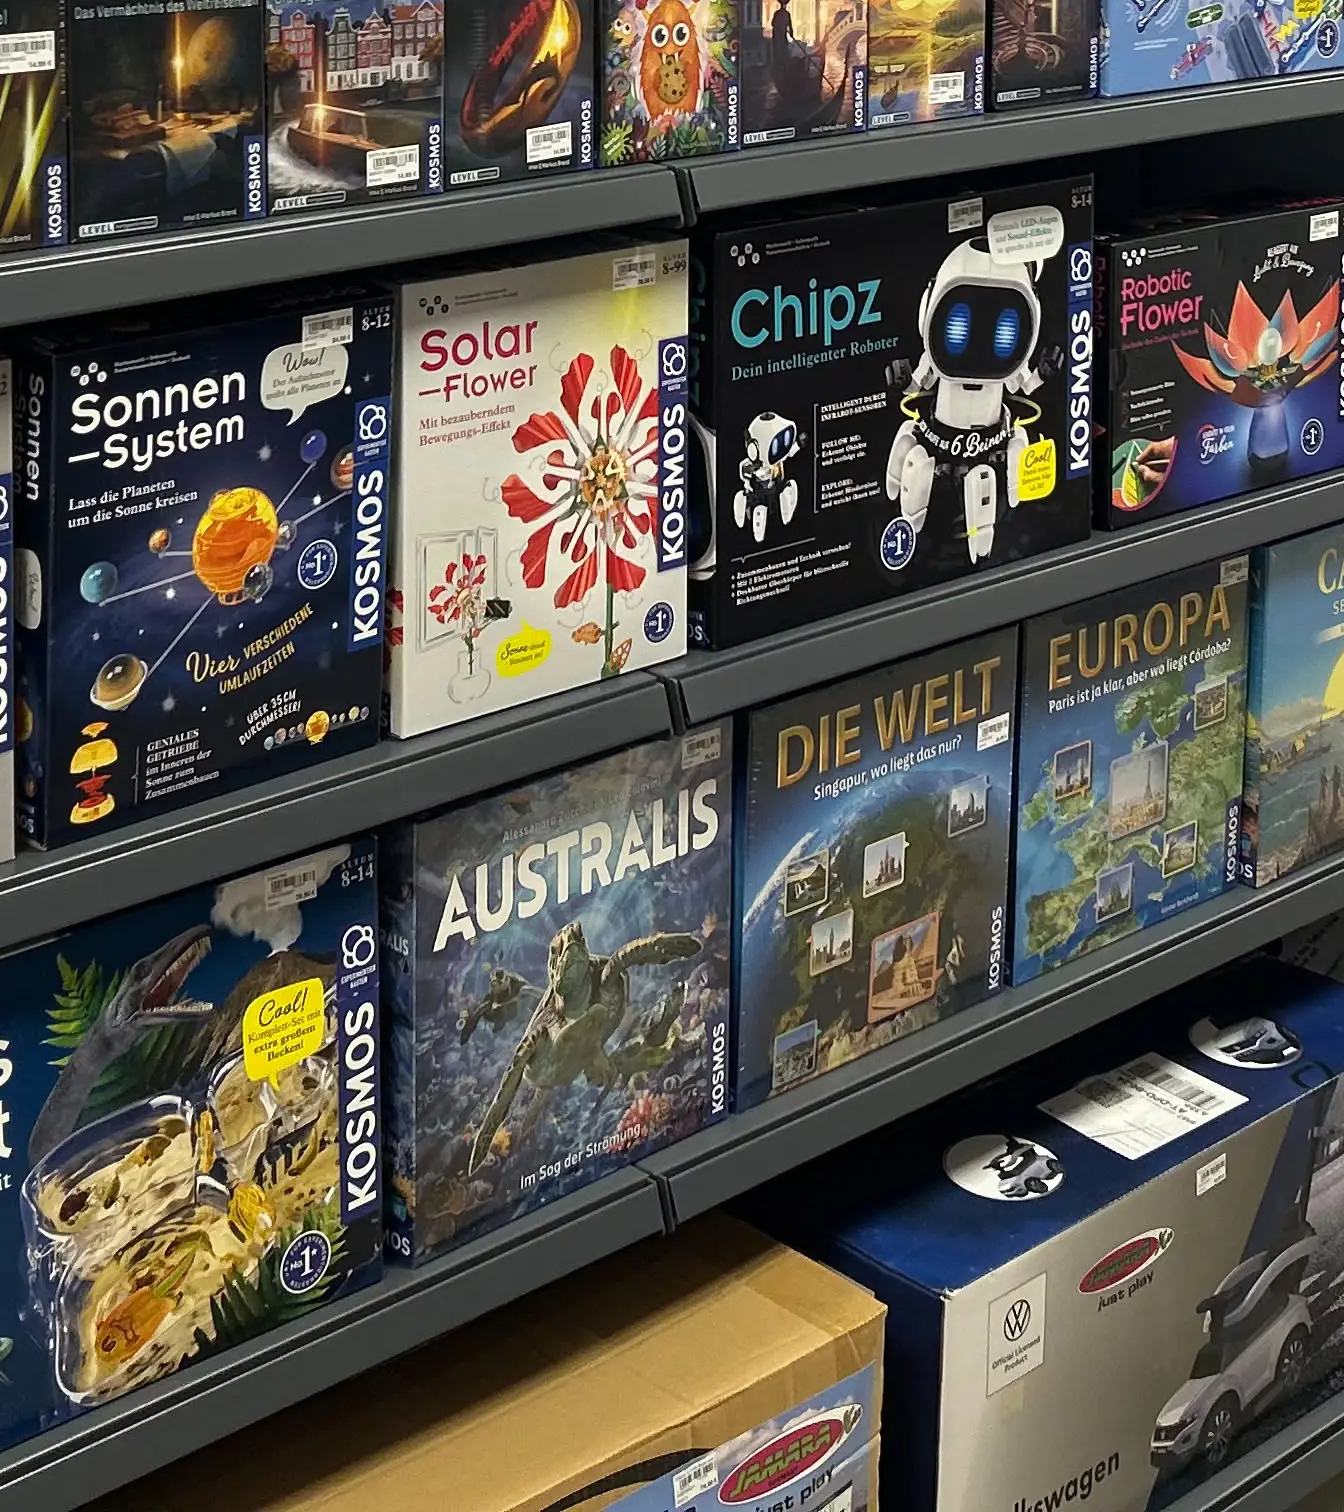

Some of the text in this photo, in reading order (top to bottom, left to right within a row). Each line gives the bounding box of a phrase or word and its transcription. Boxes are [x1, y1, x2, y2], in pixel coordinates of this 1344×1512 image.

[48, 164, 62, 238] KOSMOS
[730, 277, 883, 349] Chipz
[1120, 293, 1204, 336] Flower
[1121, 268, 1192, 303] Robotic
[420, 321, 539, 372] Solar
[731, 335, 899, 382] Dein intelligenter Roboter
[71, 371, 246, 434] Sonnen
[1069, 309, 1091, 471] KOSMOS
[68, 479, 175, 512] Lass die Planeten
[68, 489, 198, 529] um die Sonne kreisen
[661, 403, 686, 564] KOSMOS
[352, 470, 384, 643] KOSMOS
[186, 602, 314, 683] Vier VERSCHIEDENE
[219, 641, 296, 695] UMLAUFZEITEN
[1049, 583, 1233, 691] EUROPA
[1049, 692, 1074, 713] Paris
[1077, 689, 1090, 706] ist
[1091, 686, 1101, 705] ja
[1126, 669, 1148, 689] aber
[1150, 664, 1165, 677] wo
[1166, 652, 1188, 674] liegt
[1189, 638, 1232, 664] Córdoba?
[776, 656, 1003, 789] DIE WELT
[813, 735, 962, 801] Singapur, wo liegt das nur?
[341, 863, 375, 888] 8-14
[432, 777, 721, 954] AUSTRALIS
[259, 987, 308, 1027] Cool!
[711, 1022, 725, 1114] KOSMOS
[346, 1002, 378, 1212] KOSMOS
[520, 1121, 641, 1190] Im Sog der Strömung
[1097, 1269, 1155, 1312] just play
[728, 1422, 832, 1500] JAMARA
